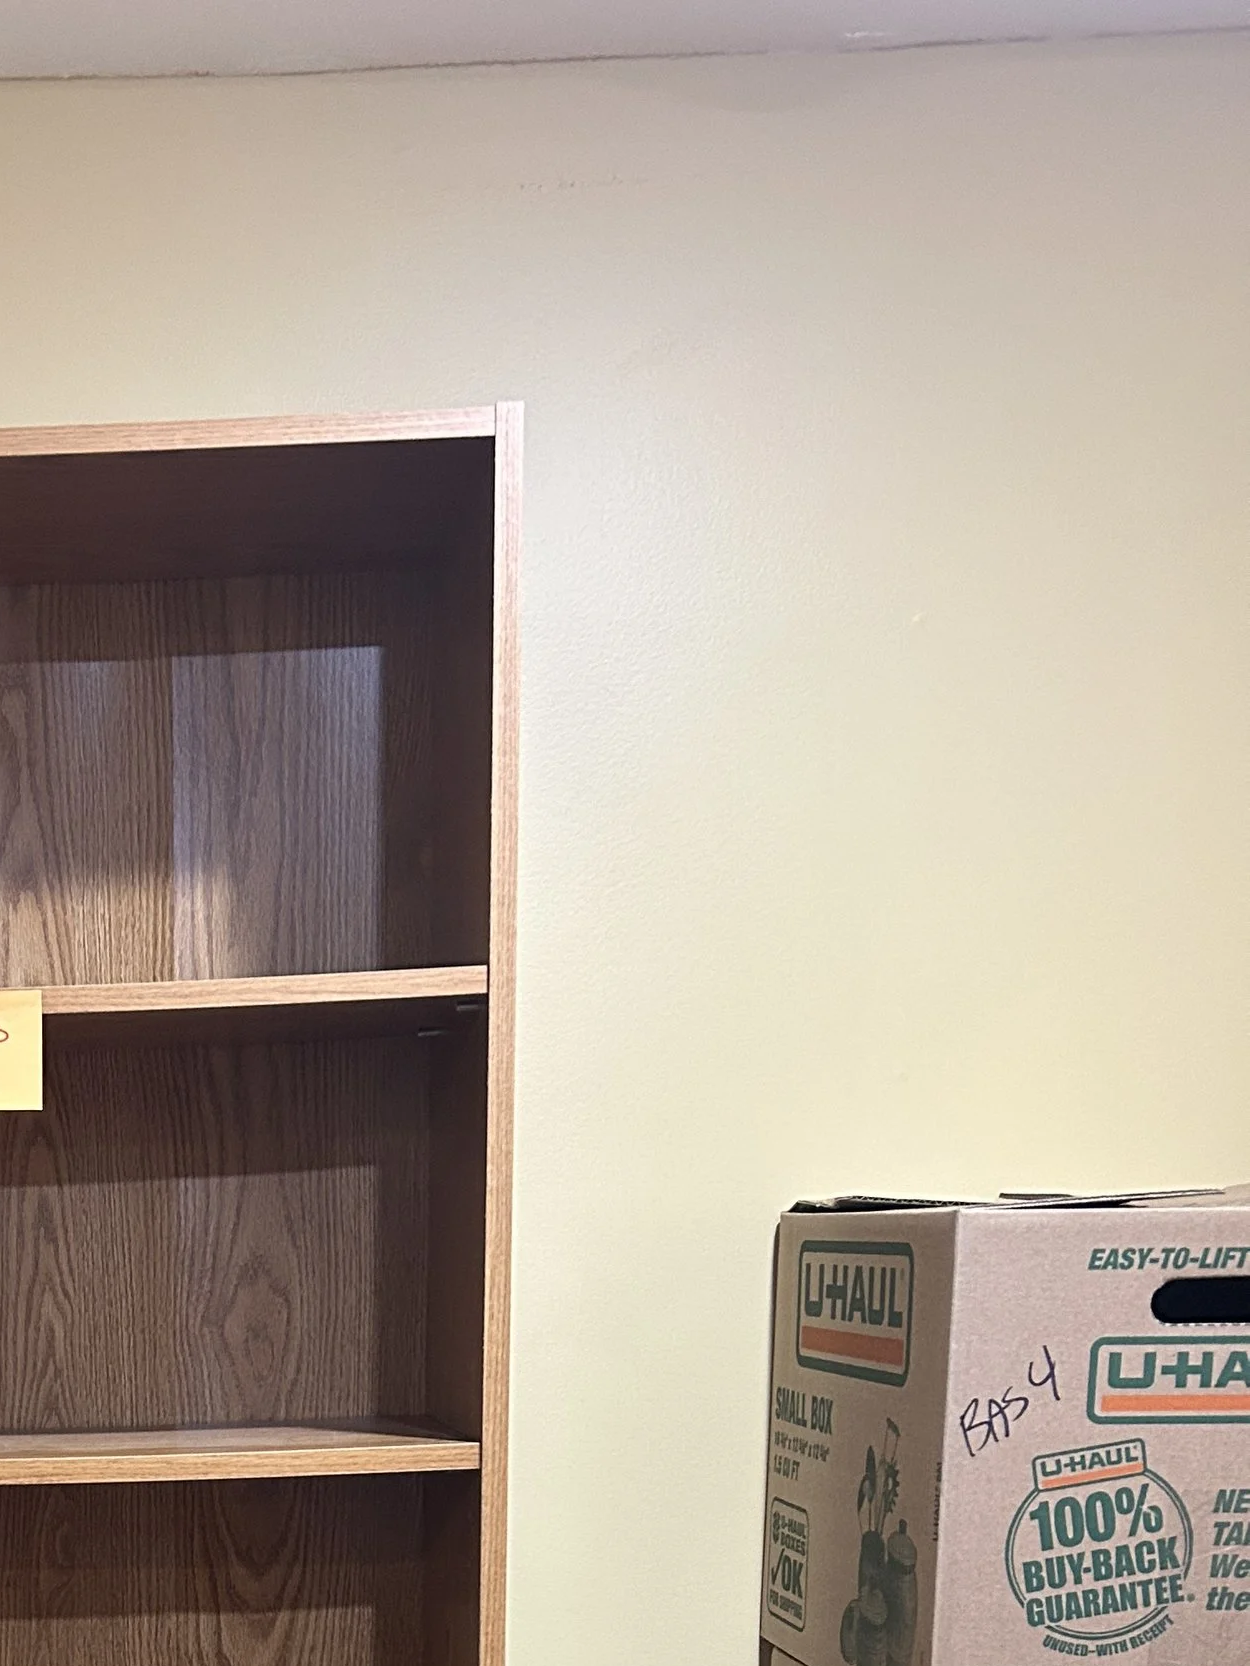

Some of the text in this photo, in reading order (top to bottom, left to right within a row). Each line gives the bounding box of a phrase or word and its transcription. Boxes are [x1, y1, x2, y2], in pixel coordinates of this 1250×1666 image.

[804, 1263, 903, 1328] U-HAUL
[775, 1386, 834, 1435] SMALL BOX
[1040, 1445, 1139, 1477] U-HAUL
[1029, 1483, 1163, 1551] 100%
[781, 1555, 803, 1599] OK
[1022, 1536, 1180, 1593] BUY-BACK
[1130, 1613, 1174, 1649] RECEIPT
